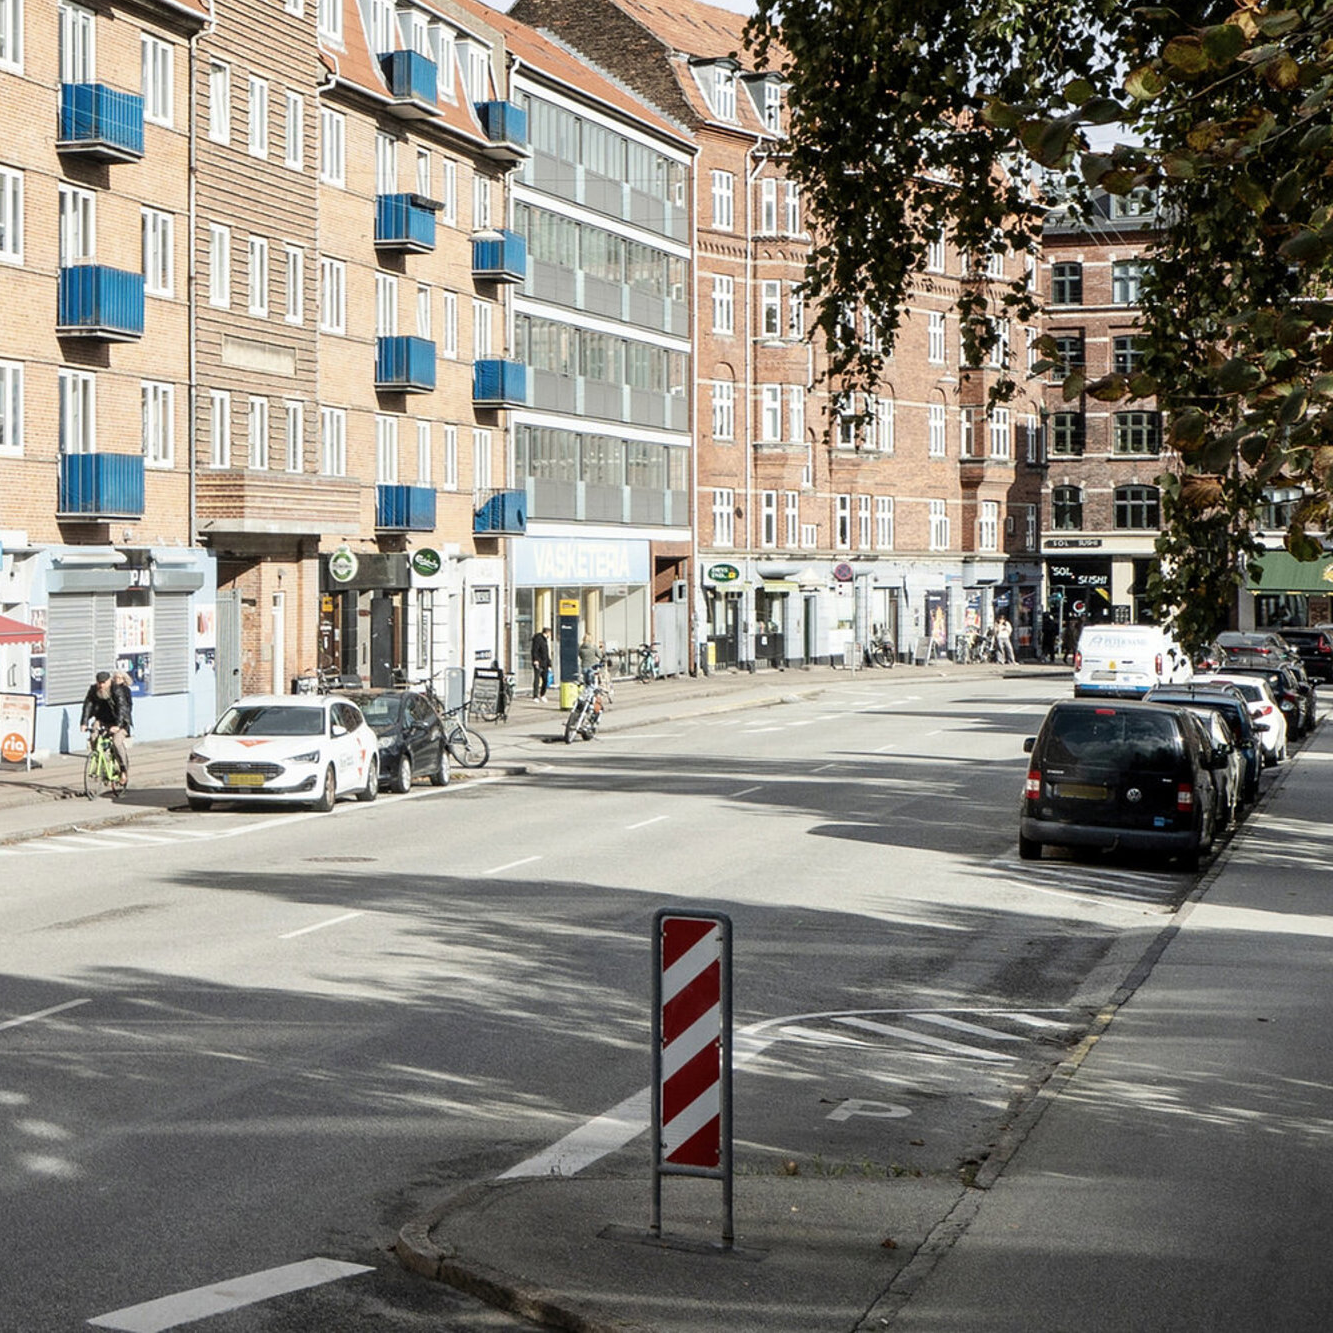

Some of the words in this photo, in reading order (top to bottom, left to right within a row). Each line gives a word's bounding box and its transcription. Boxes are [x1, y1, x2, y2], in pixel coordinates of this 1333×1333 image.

[1077, 539, 1100, 547] SUSHI
[534, 542, 631, 579] VASKETERIA
[1052, 566, 1073, 577] SOL
[1077, 574, 1109, 585] SUSHI
[3, 735, 25, 751] ria
[825, 1097, 913, 1122] P
